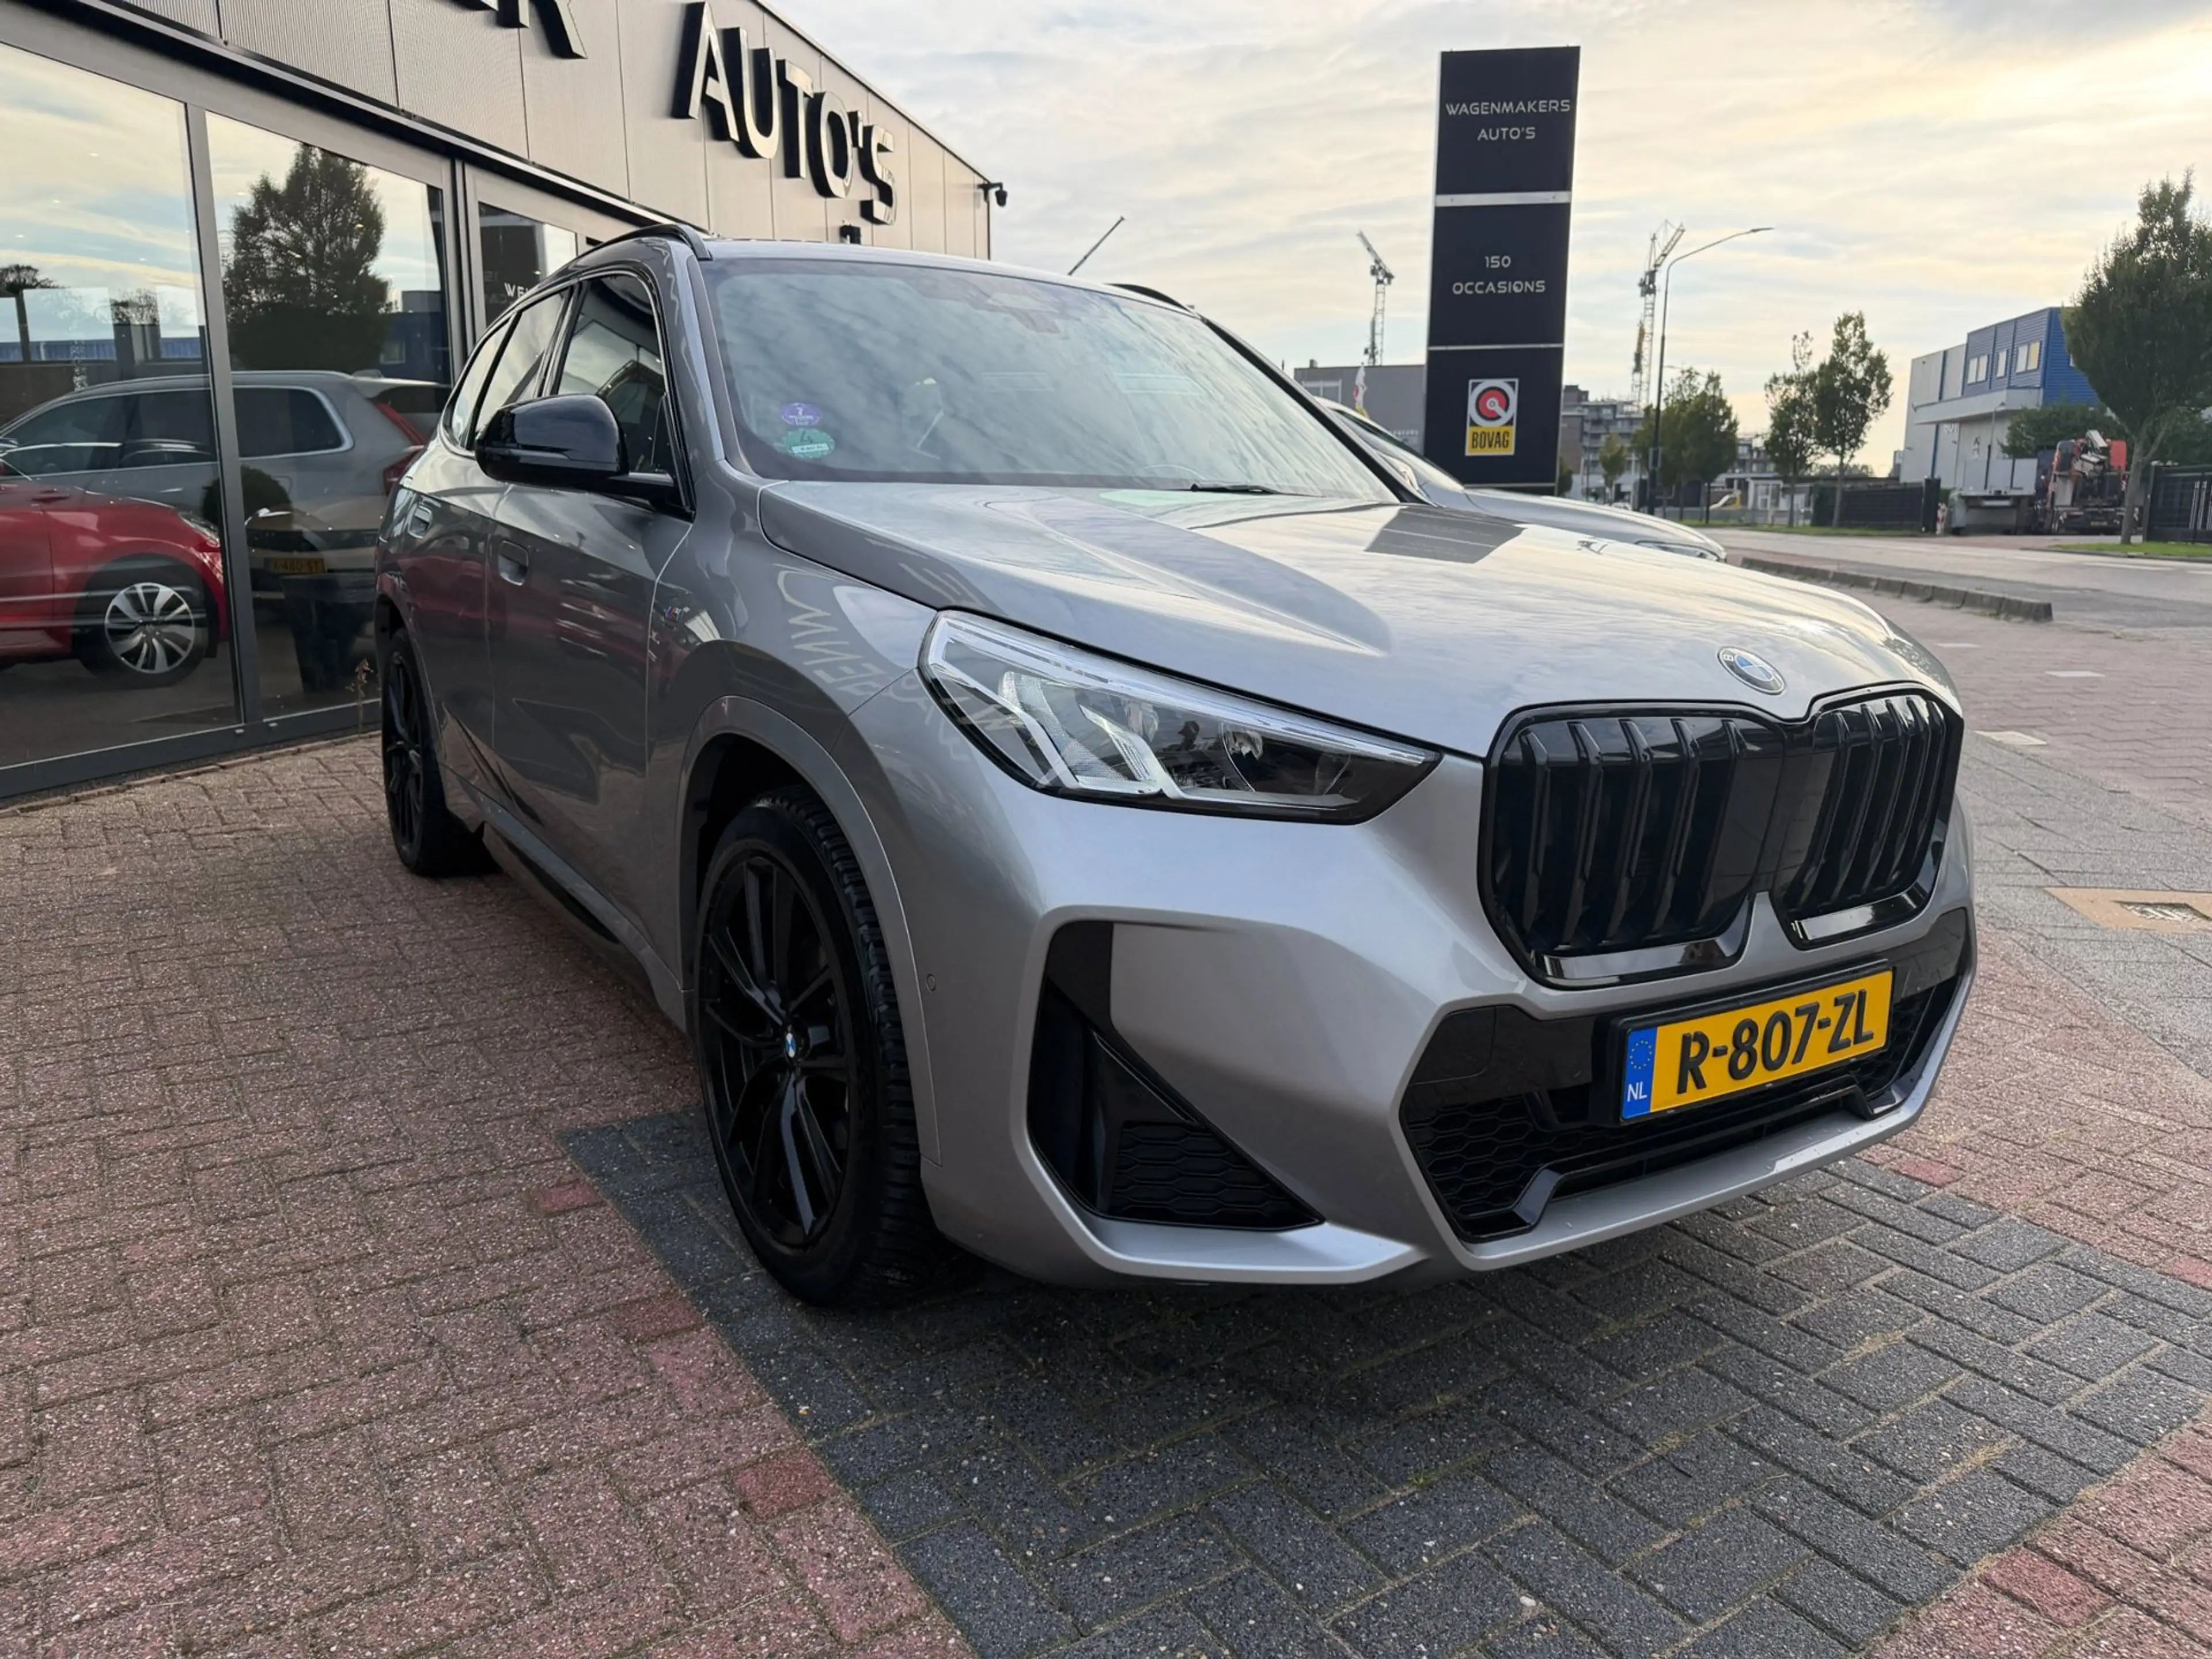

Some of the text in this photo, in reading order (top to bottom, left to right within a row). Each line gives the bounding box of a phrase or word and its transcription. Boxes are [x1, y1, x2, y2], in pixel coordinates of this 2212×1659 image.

[672, 2, 896, 225] AUTO'S
[1445, 100, 1571, 116] WAGENMAKERS
[1476, 127, 1536, 141] AUTO'S
[1484, 255, 1512, 268] 150
[1452, 280, 1546, 294] OCCASIONS
[1471, 430, 1510, 449] BOVAG
[1677, 989, 1874, 1095] R-807-ZL
[1627, 1083, 1647, 1102] NL
